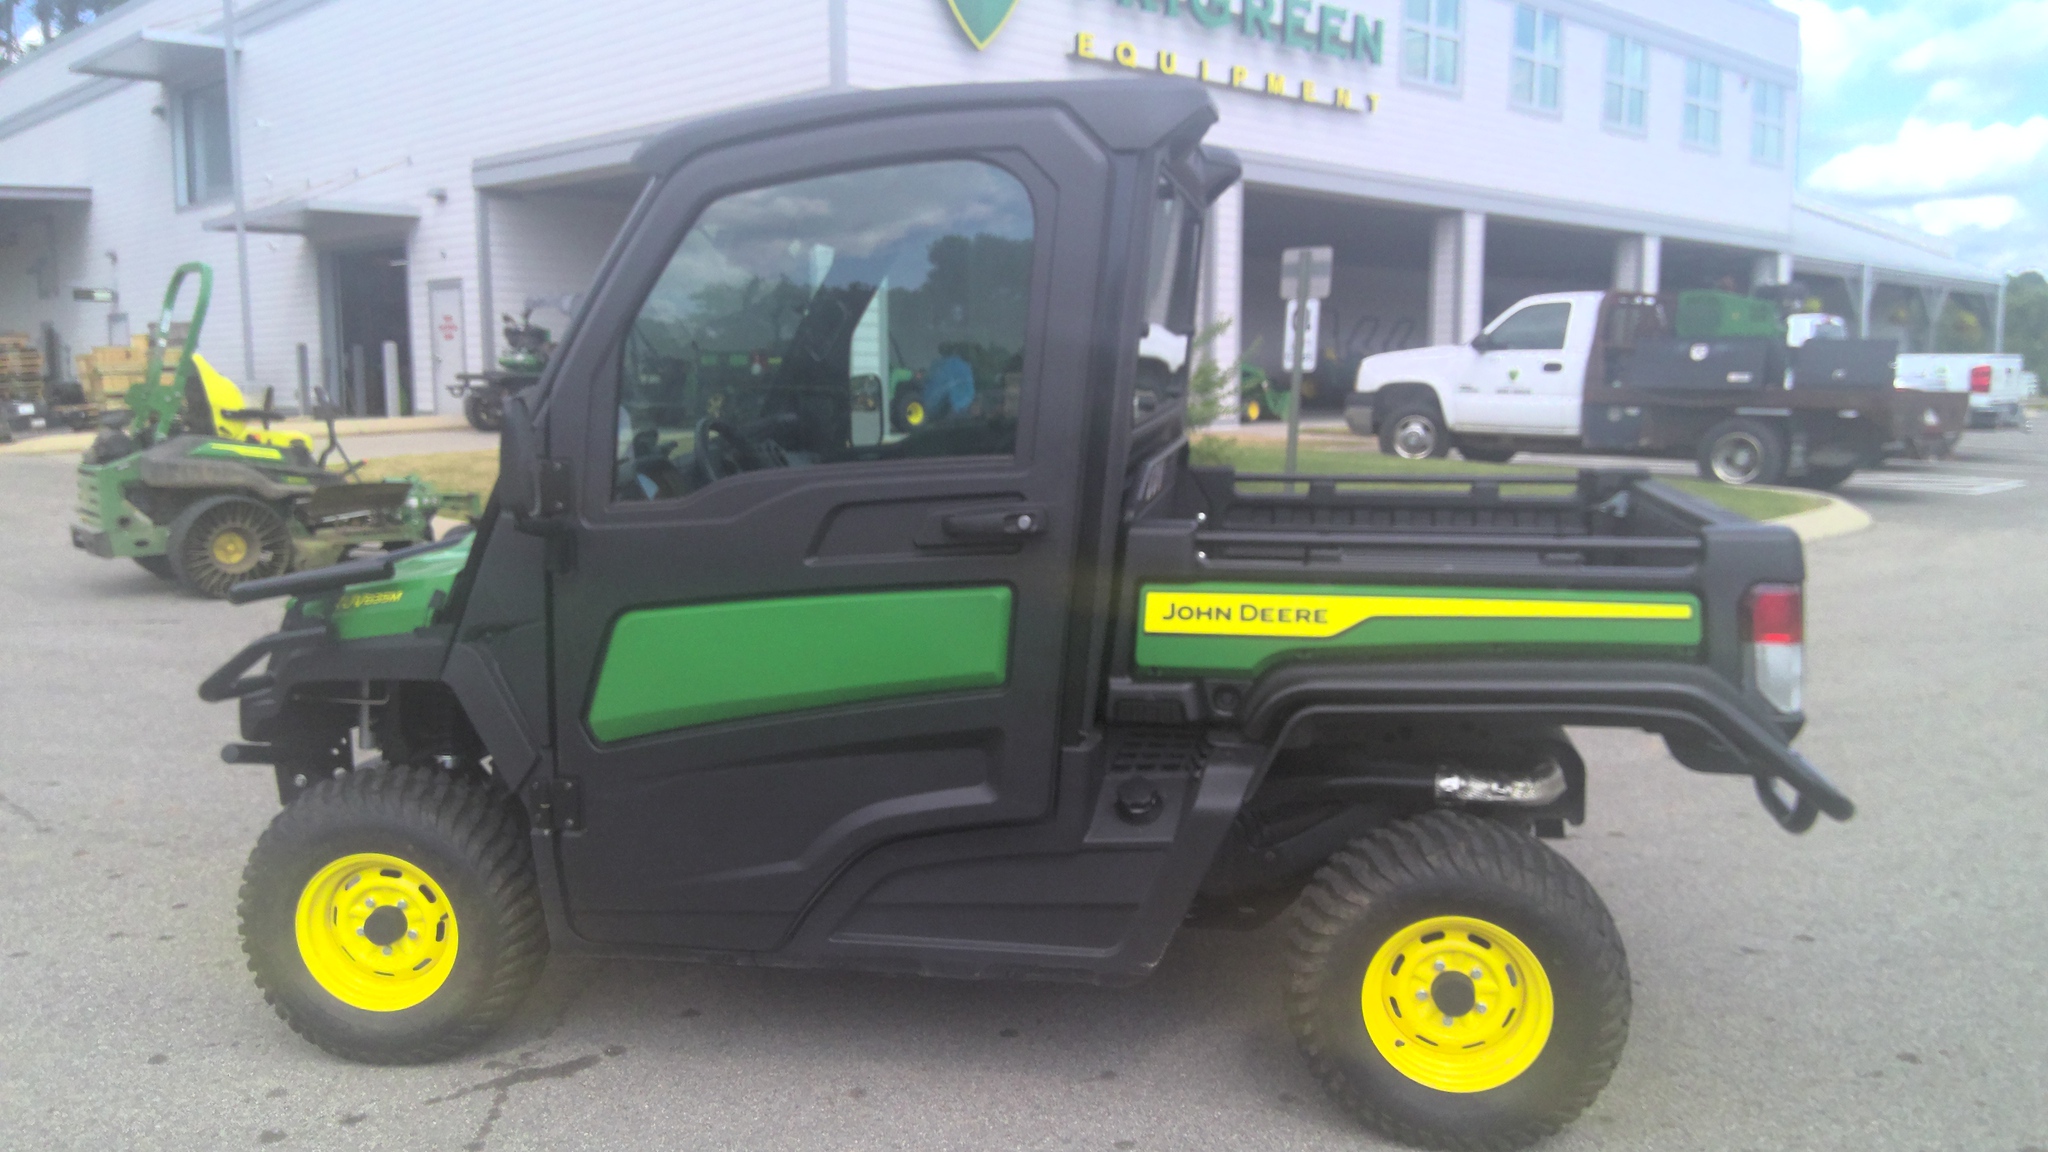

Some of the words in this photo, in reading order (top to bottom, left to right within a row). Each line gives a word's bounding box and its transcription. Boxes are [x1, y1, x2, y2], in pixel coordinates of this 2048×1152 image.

[1116, 0, 1384, 65] GREEN
[1076, 31, 1380, 112] EQUIPMENT
[1163, 603, 1232, 621] JOHN
[1240, 604, 1328, 624] DEERE
